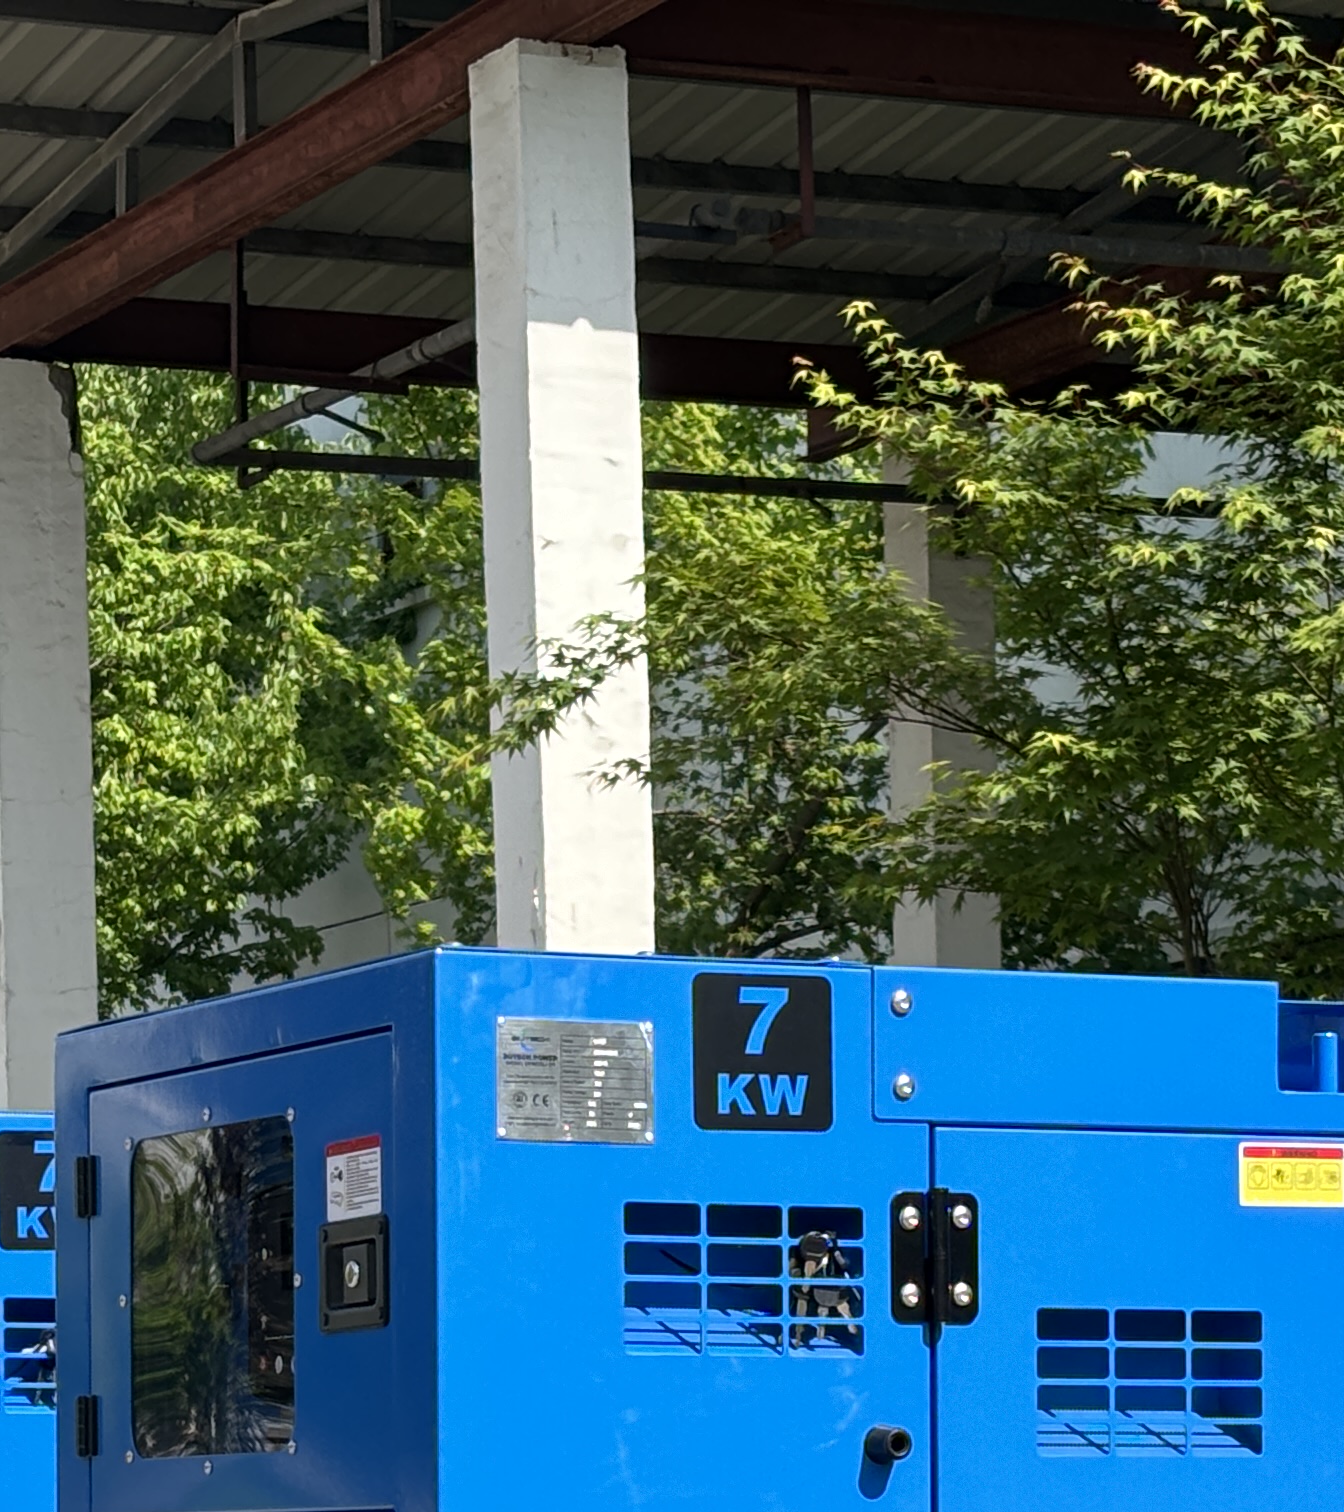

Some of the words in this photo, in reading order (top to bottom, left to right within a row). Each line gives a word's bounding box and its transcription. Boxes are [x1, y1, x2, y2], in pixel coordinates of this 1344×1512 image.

[739, 986, 790, 1055] 7
[717, 1073, 809, 1117] KW
[16, 1206, 56, 1239] K
